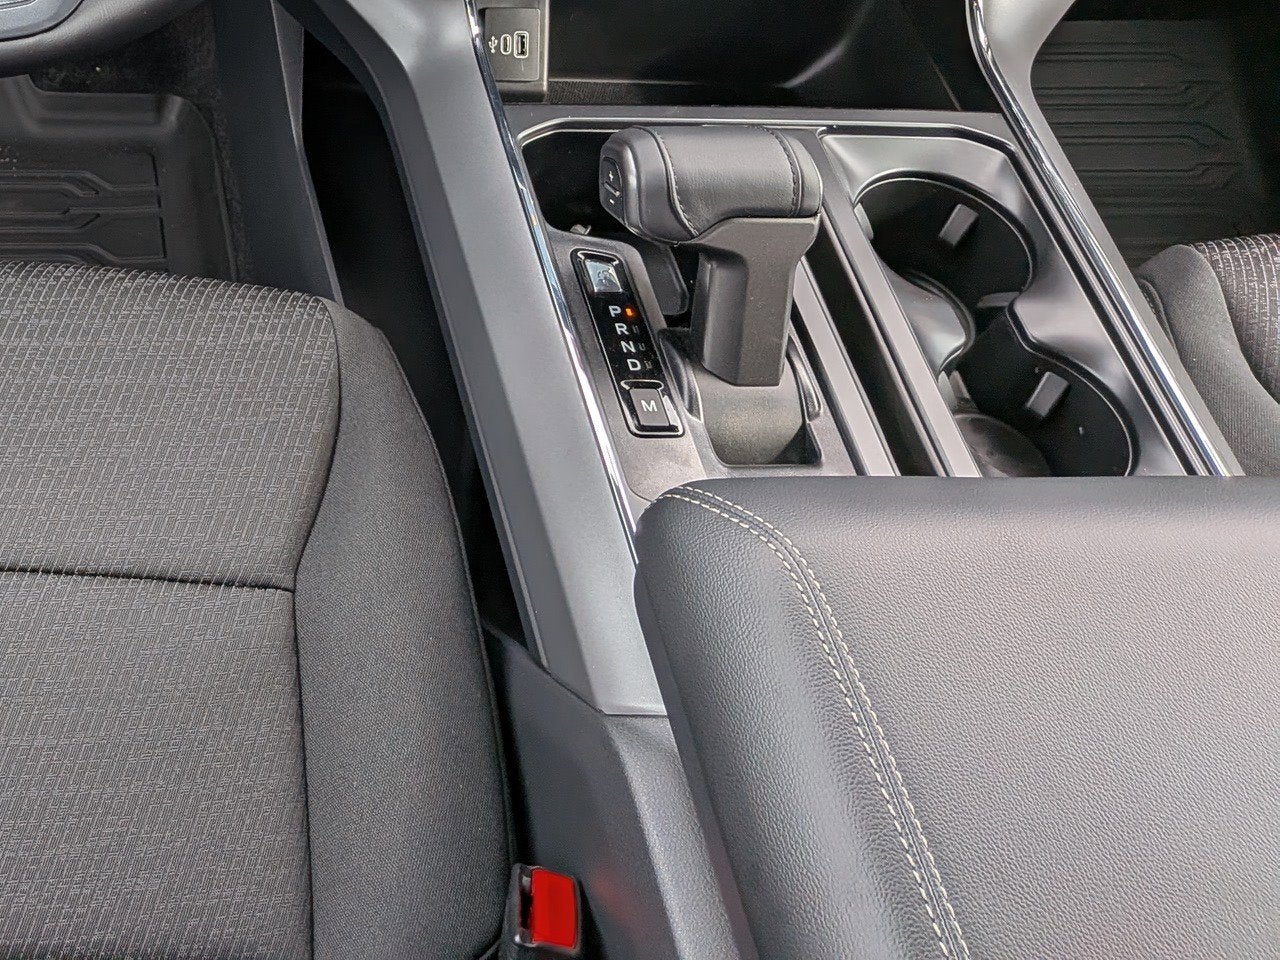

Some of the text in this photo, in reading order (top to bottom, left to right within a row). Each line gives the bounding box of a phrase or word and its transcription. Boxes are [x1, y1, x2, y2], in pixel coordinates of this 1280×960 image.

[608, 305, 621, 317] P
[615, 323, 629, 335] R
[620, 340, 637, 353] N
[627, 358, 641, 371] D
[640, 400, 658, 412] M
